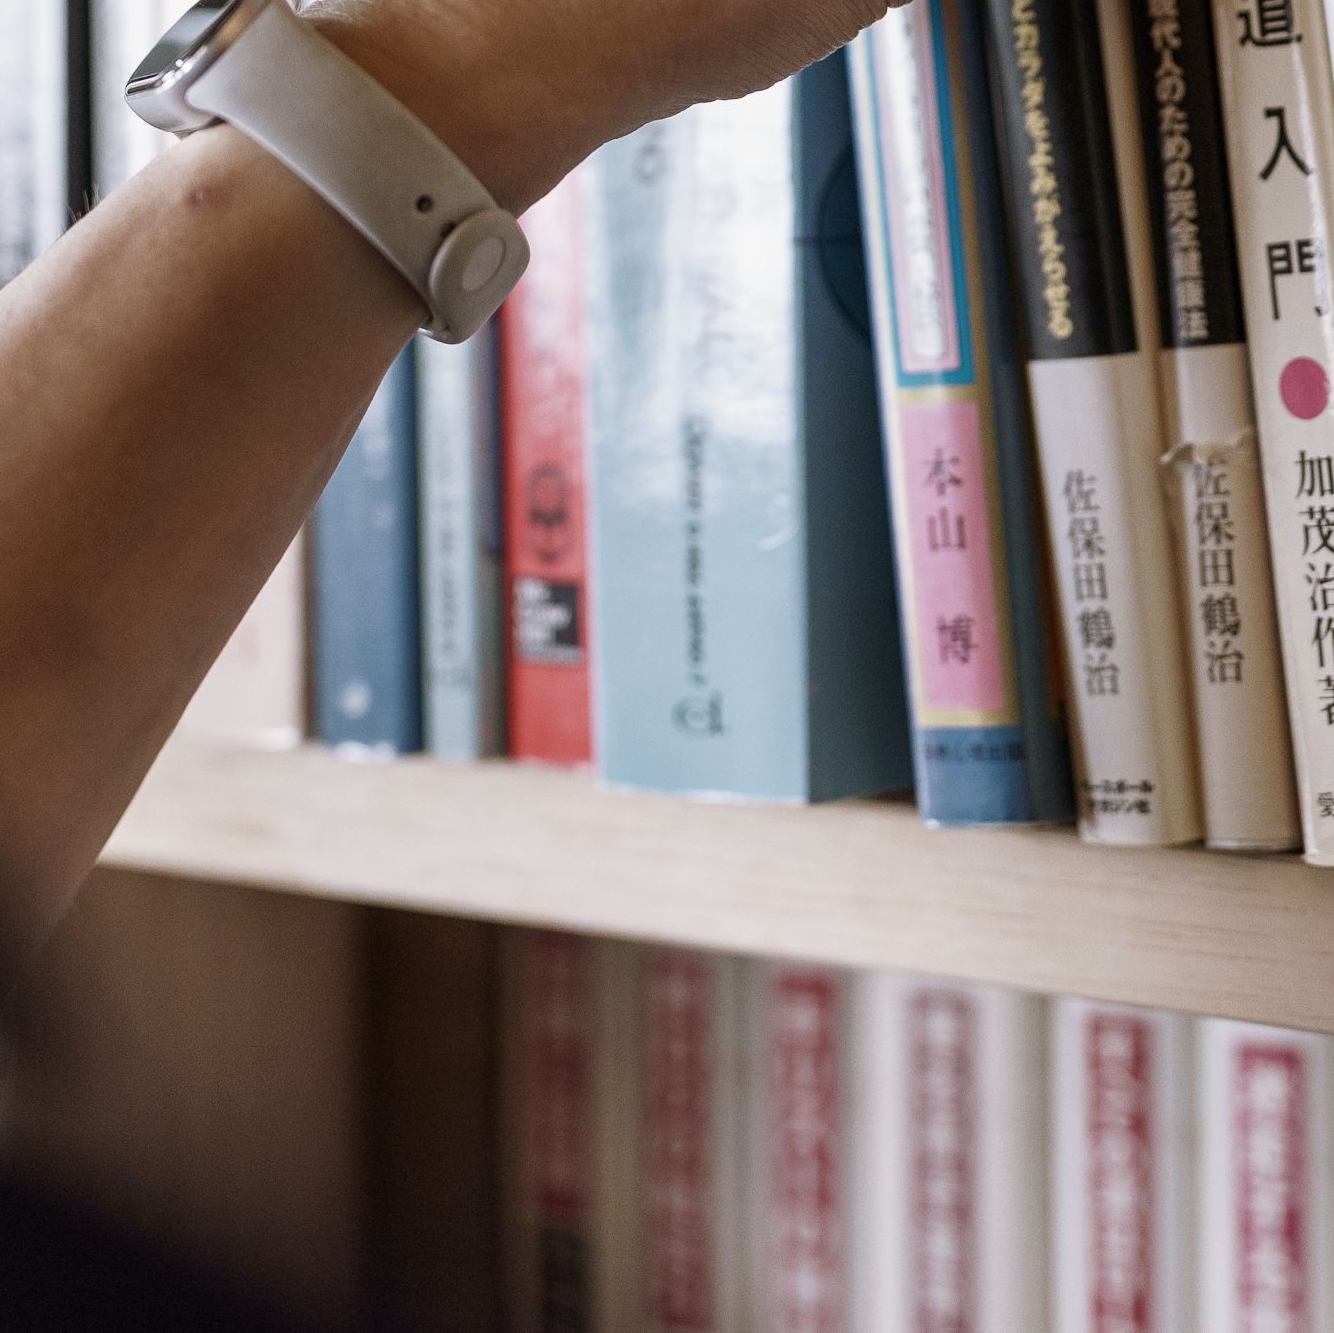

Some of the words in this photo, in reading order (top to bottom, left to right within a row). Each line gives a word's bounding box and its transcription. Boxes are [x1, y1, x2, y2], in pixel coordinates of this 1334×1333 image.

[1062, 467, 1120, 698] 佐保田鶴治
[1193, 452, 1245, 684] 佐保田鶴治
